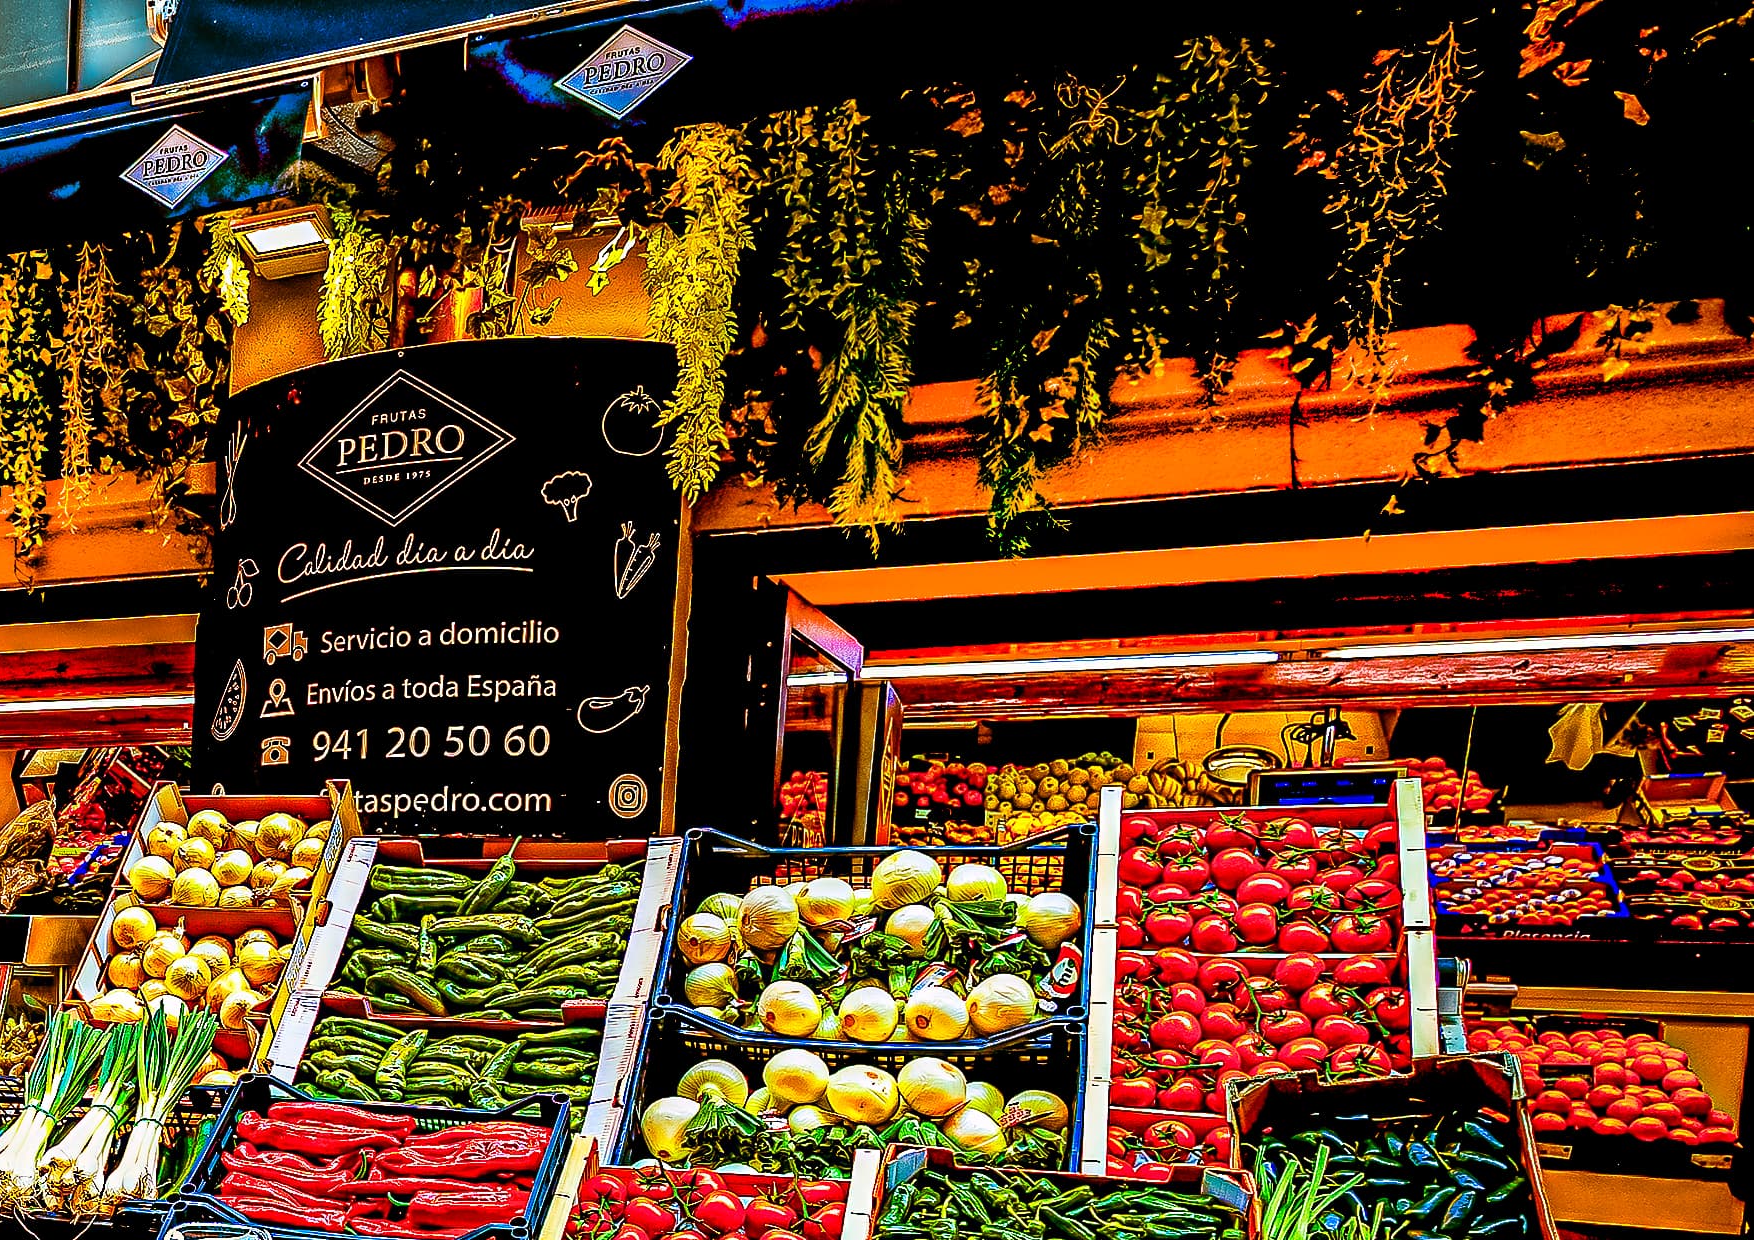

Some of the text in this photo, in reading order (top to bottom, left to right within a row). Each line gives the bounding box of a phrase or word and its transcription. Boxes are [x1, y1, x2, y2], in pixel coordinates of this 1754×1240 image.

[583, 52, 666, 84] PEDRO
[605, 46, 641, 60] FRUTAS
[142, 150, 207, 177] PEDRO
[371, 408, 427, 425] FRUTAS
[336, 424, 465, 467] PEDRO
[363, 470, 431, 485] DESDE 1975
[277, 528, 535, 583] Calidad día a día
[320, 620, 560, 653] Servicio a domicilio
[307, 675, 557, 705] Envíos a toda España
[313, 725, 551, 762] 941 20 50 60
[320, 786, 552, 819] taspedro.com
